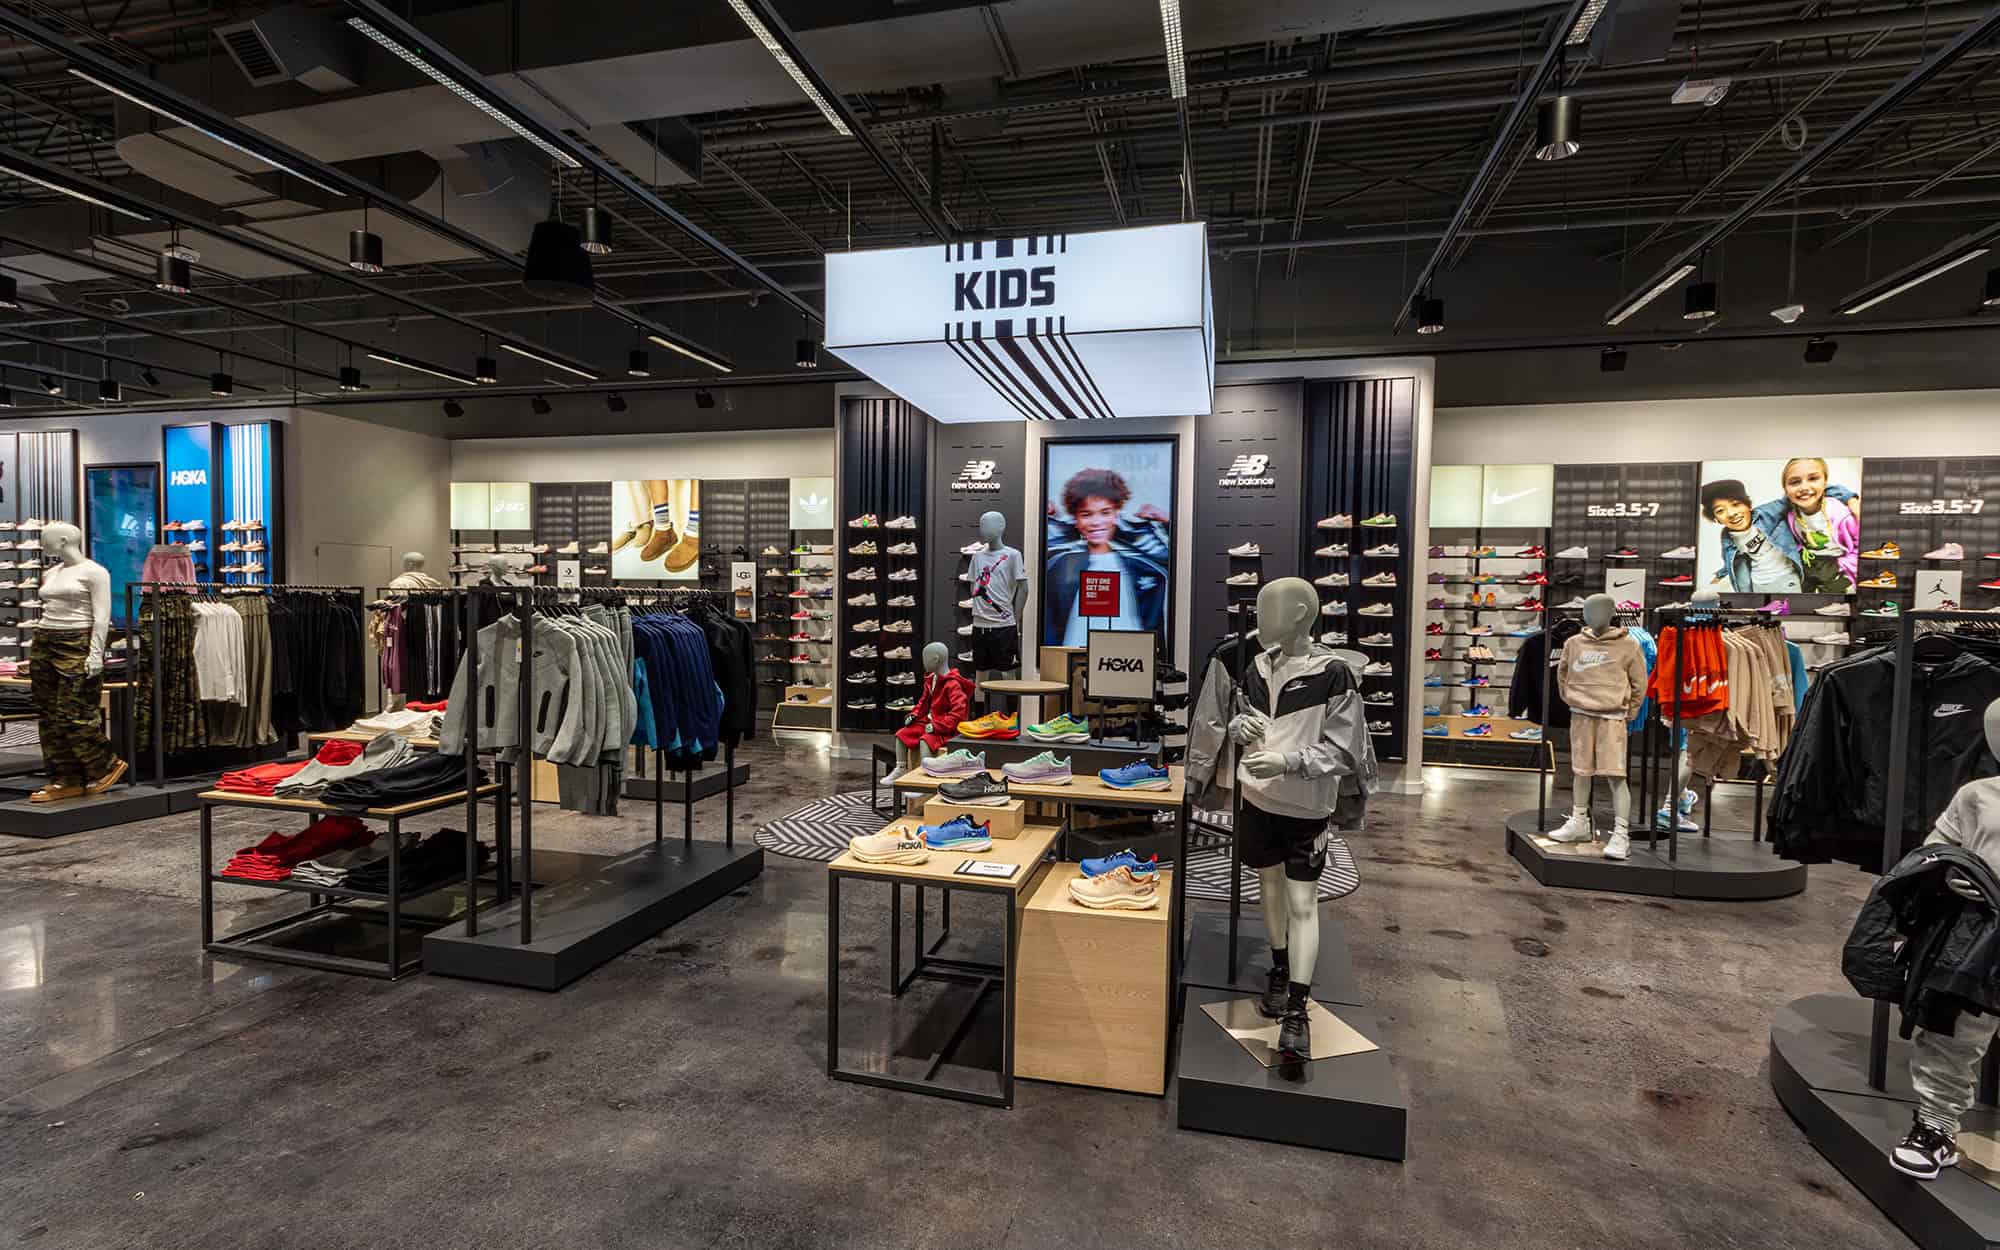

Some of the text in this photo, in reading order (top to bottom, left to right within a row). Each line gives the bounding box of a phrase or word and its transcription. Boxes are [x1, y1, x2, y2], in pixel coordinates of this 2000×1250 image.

[954, 265, 1056, 311] KIDS
[170, 469, 207, 486] HOKA
[1238, 477, 1274, 486] balance
[968, 481, 1000, 489] balance
[735, 570, 752, 580] UGG
[1098, 657, 1144, 672] HOKA
[984, 783, 1007, 793] HOKA
[896, 841, 922, 850] HOKA
